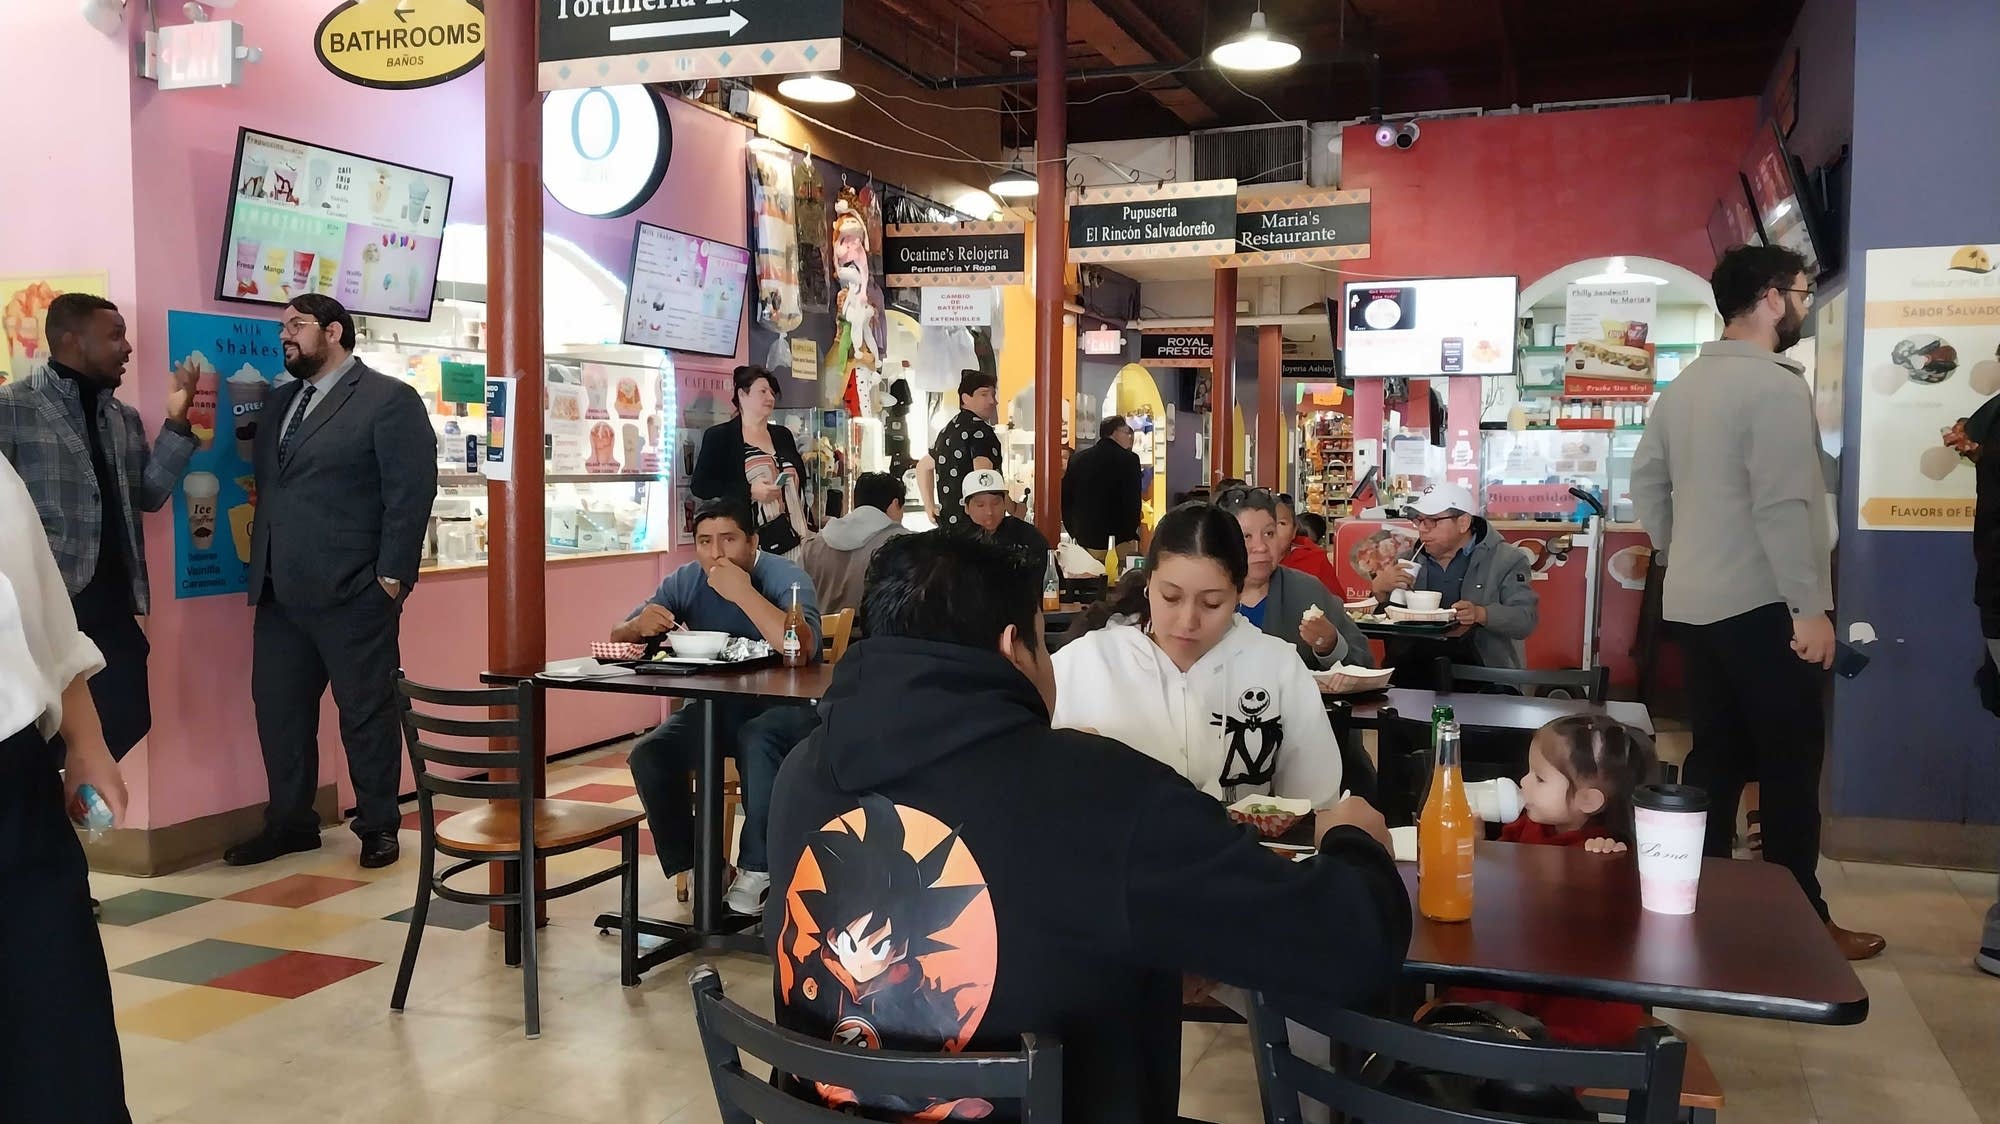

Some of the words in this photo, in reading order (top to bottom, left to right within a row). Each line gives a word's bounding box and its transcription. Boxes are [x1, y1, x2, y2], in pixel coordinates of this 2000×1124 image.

[557, 0, 697, 19] Tortiller
[330, 22, 482, 53] BATHROOMS
[386, 53, 424, 68] BAÑOS
[1261, 211, 1320, 229] Maria's
[1086, 227, 1098, 242] El
[1102, 225, 1141, 242] Rincón
[1145, 221, 1215, 239] Salvadoreño
[1241, 228, 1336, 246] Restaurante
[900, 247, 955, 262] Ocatime's
[973, 264, 997, 272] Ropa
[232, 322, 262, 337] Milk
[215, 338, 279, 357] Shakes
[1167, 337, 1209, 346] ROYAL
[1308, 364, 1333, 374] Ashley
[194, 504, 212, 514] Ice
[1891, 505, 1943, 517] FLAVORS
[1946, 507, 1961, 517] OF
